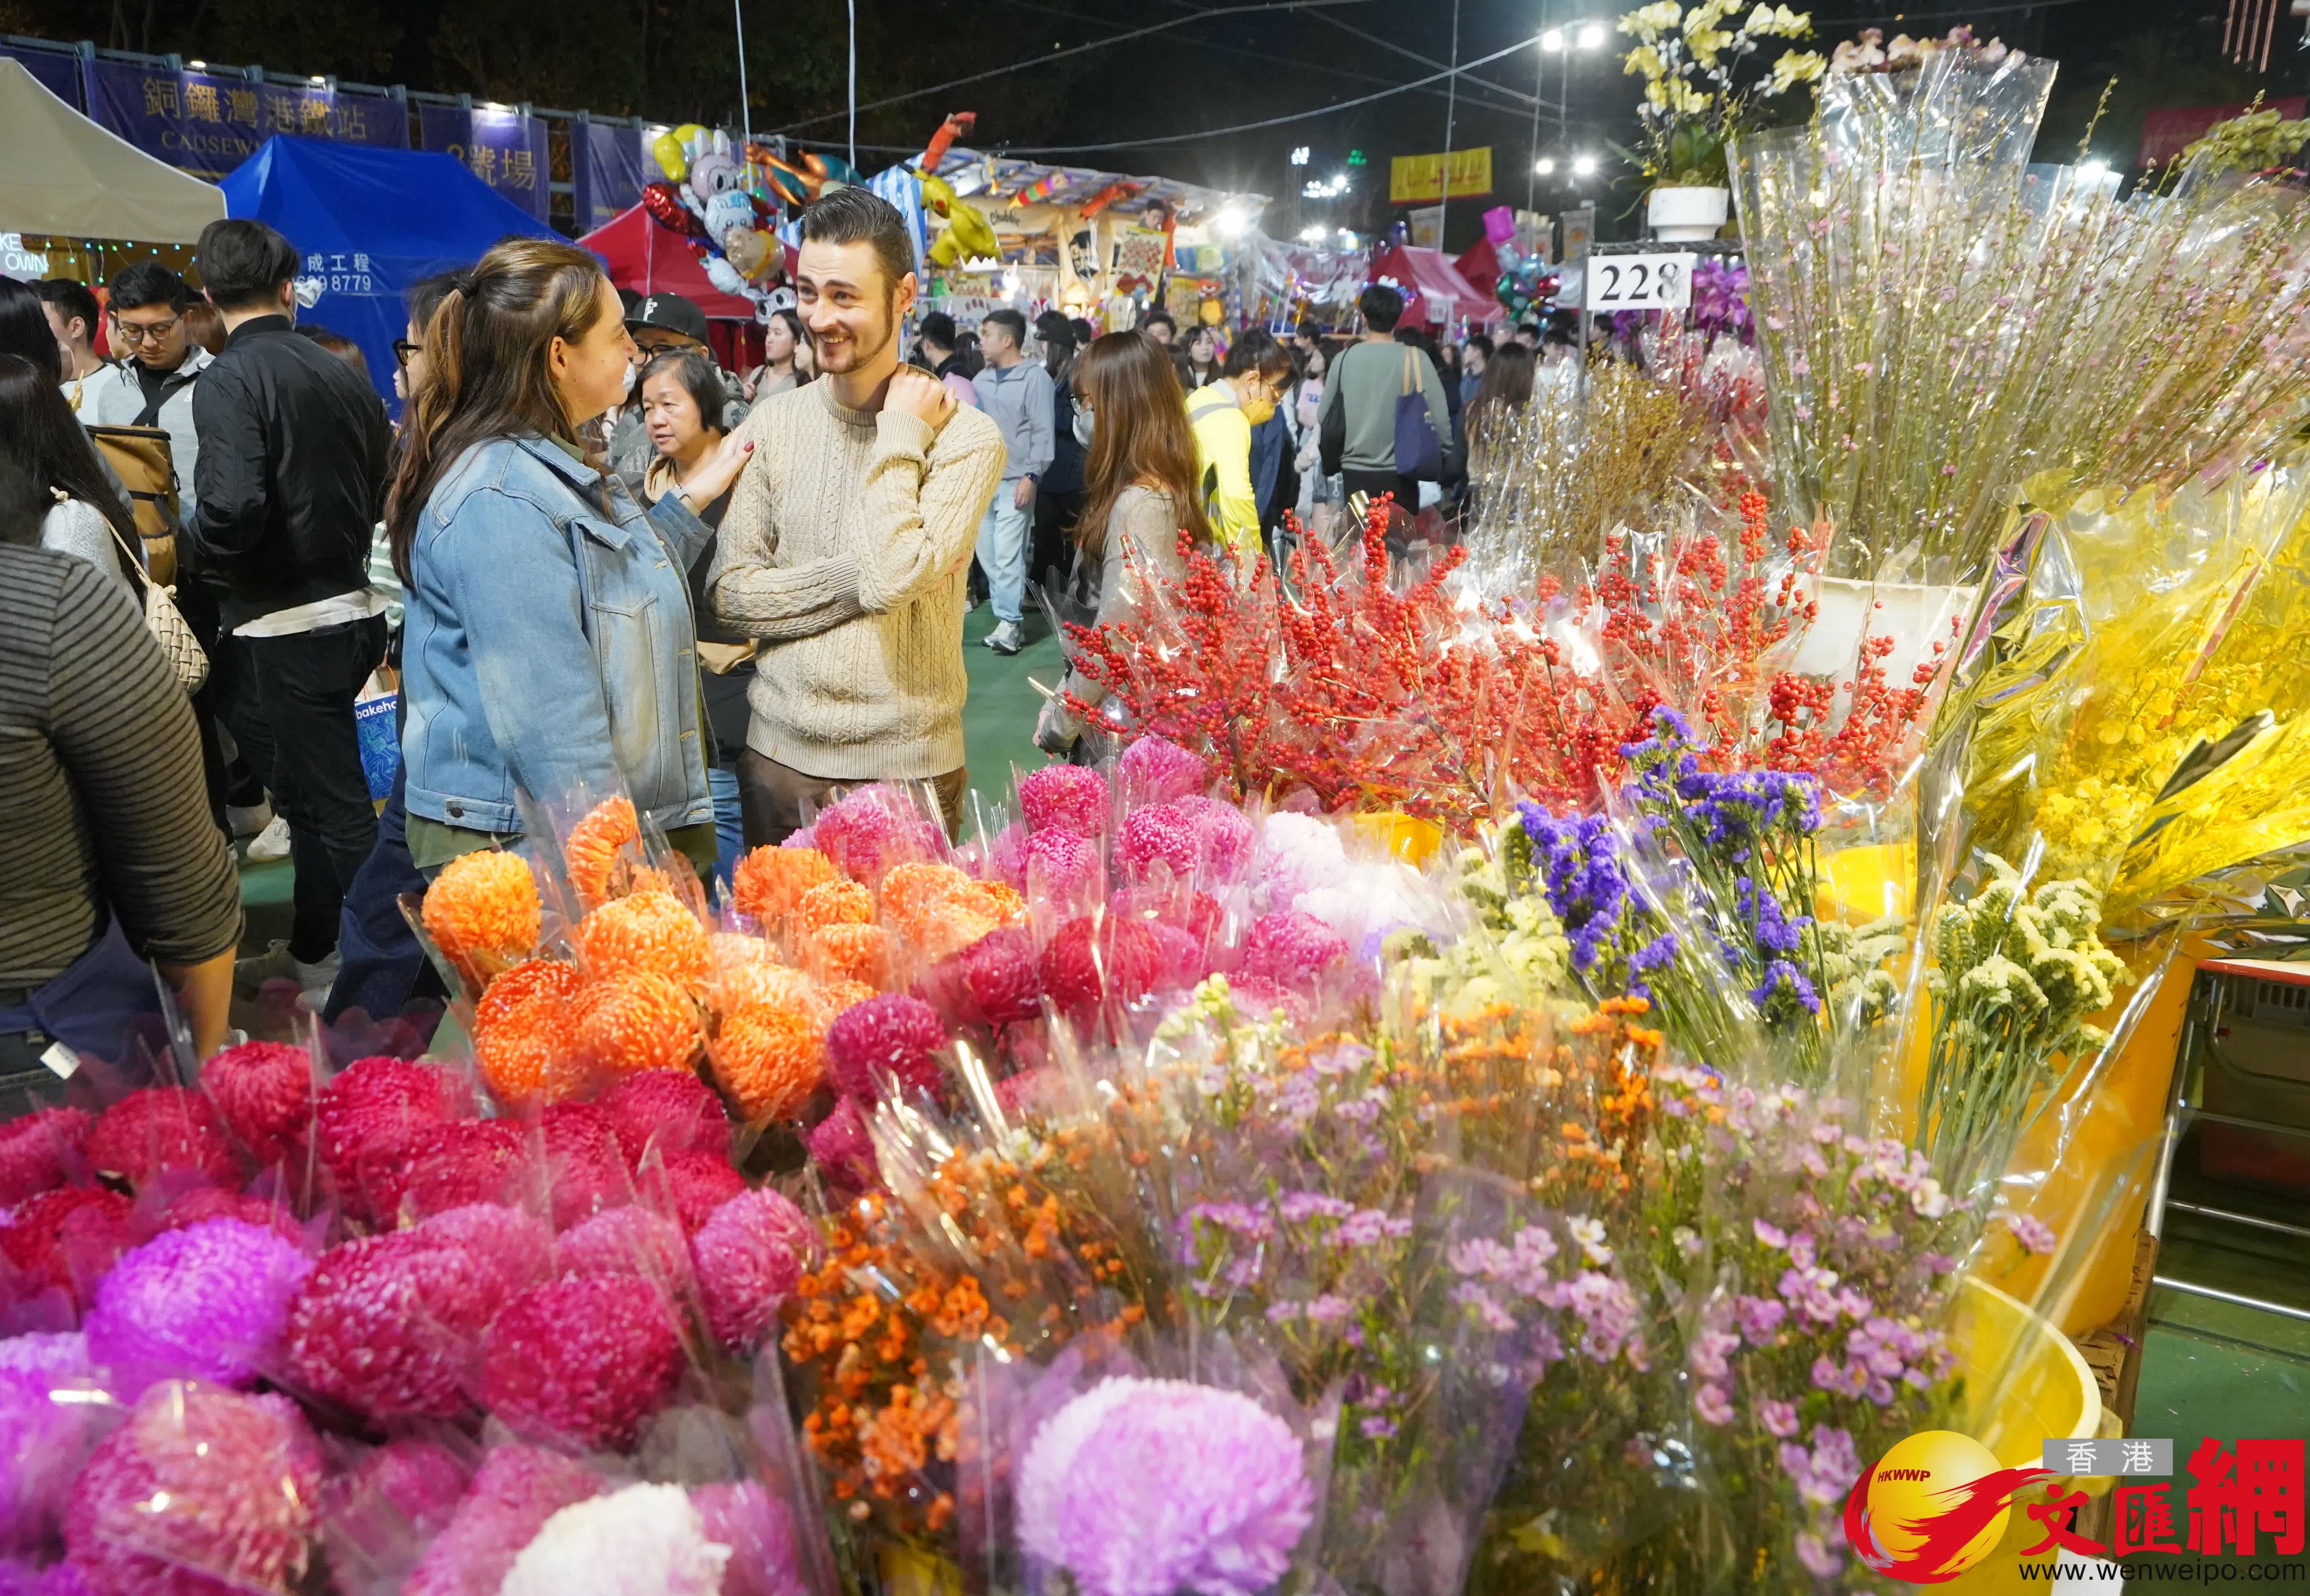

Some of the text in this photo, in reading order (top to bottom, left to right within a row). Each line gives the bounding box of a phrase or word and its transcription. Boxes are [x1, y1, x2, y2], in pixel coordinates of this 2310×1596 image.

[143, 77, 366, 140] 銅鑼灣港鐵站
[5, 252, 48, 273] OWN
[307, 253, 370, 272] 成工程
[331, 275, 371, 292] 8779
